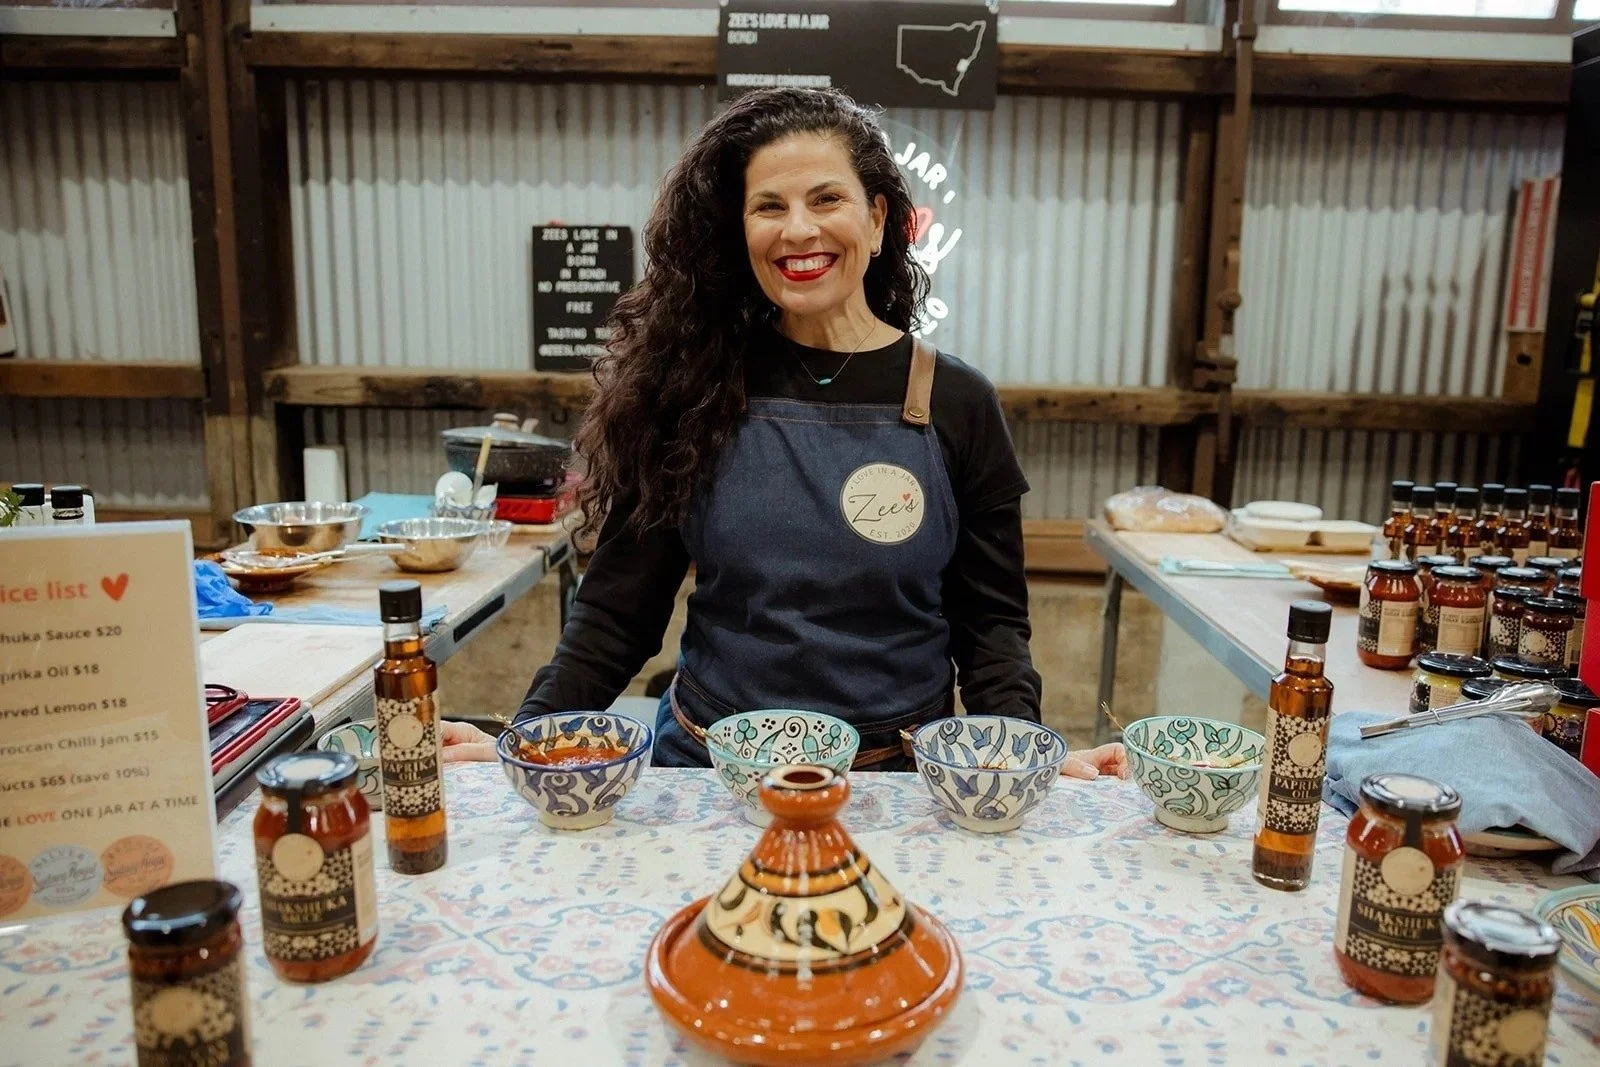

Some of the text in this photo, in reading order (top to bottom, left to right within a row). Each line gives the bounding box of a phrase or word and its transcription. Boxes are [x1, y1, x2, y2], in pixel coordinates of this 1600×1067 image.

[759, 13, 786, 29] LOVE
[787, 13, 800, 29] IN
[801, 14, 809, 29] A
[809, 14, 830, 29] JAR
[727, 31, 758, 45] BONDI
[895, 142, 947, 190] JAR
[573, 228, 599, 241] LOVE
[605, 229, 618, 241] IN
[565, 242, 599, 254] A JAR
[566, 254, 597, 267] BORN
[559, 267, 607, 280] IN BONDI
[537, 281, 553, 293] NO
[566, 301, 593, 314] FREE
[547, 327, 588, 340] TASTING
[853, 468, 874, 485] LOVE
[901, 472, 916, 487] JAR
[895, 521, 917, 538] 2020
[46, 580, 89, 601] list
[45, 629, 92, 641] Sauce
[96, 625, 123, 638] $20
[0, 662, 100, 685] prika Oil $18
[44, 701, 98, 716] Lemon
[101, 697, 128, 710] $18
[58, 735, 97, 750] Chilli
[100, 734, 130, 748] Jam
[134, 730, 160, 743] $15
[383, 758, 437, 773] PAPRIKA
[0, 766, 151, 793] ucts $65 (save 10%)
[398, 771, 422, 781] OIL
[1274, 776, 1320, 790] PAPRIK
[1291, 789, 1310, 799] OIL
[16, 811, 57, 826] LOVE
[61, 807, 94, 822] ONE
[98, 803, 124, 819] JAR
[127, 801, 147, 814] AT
[151, 800, 161, 810] A
[165, 795, 200, 809] TIME
[1356, 902, 1436, 929] SHAKSHUK
